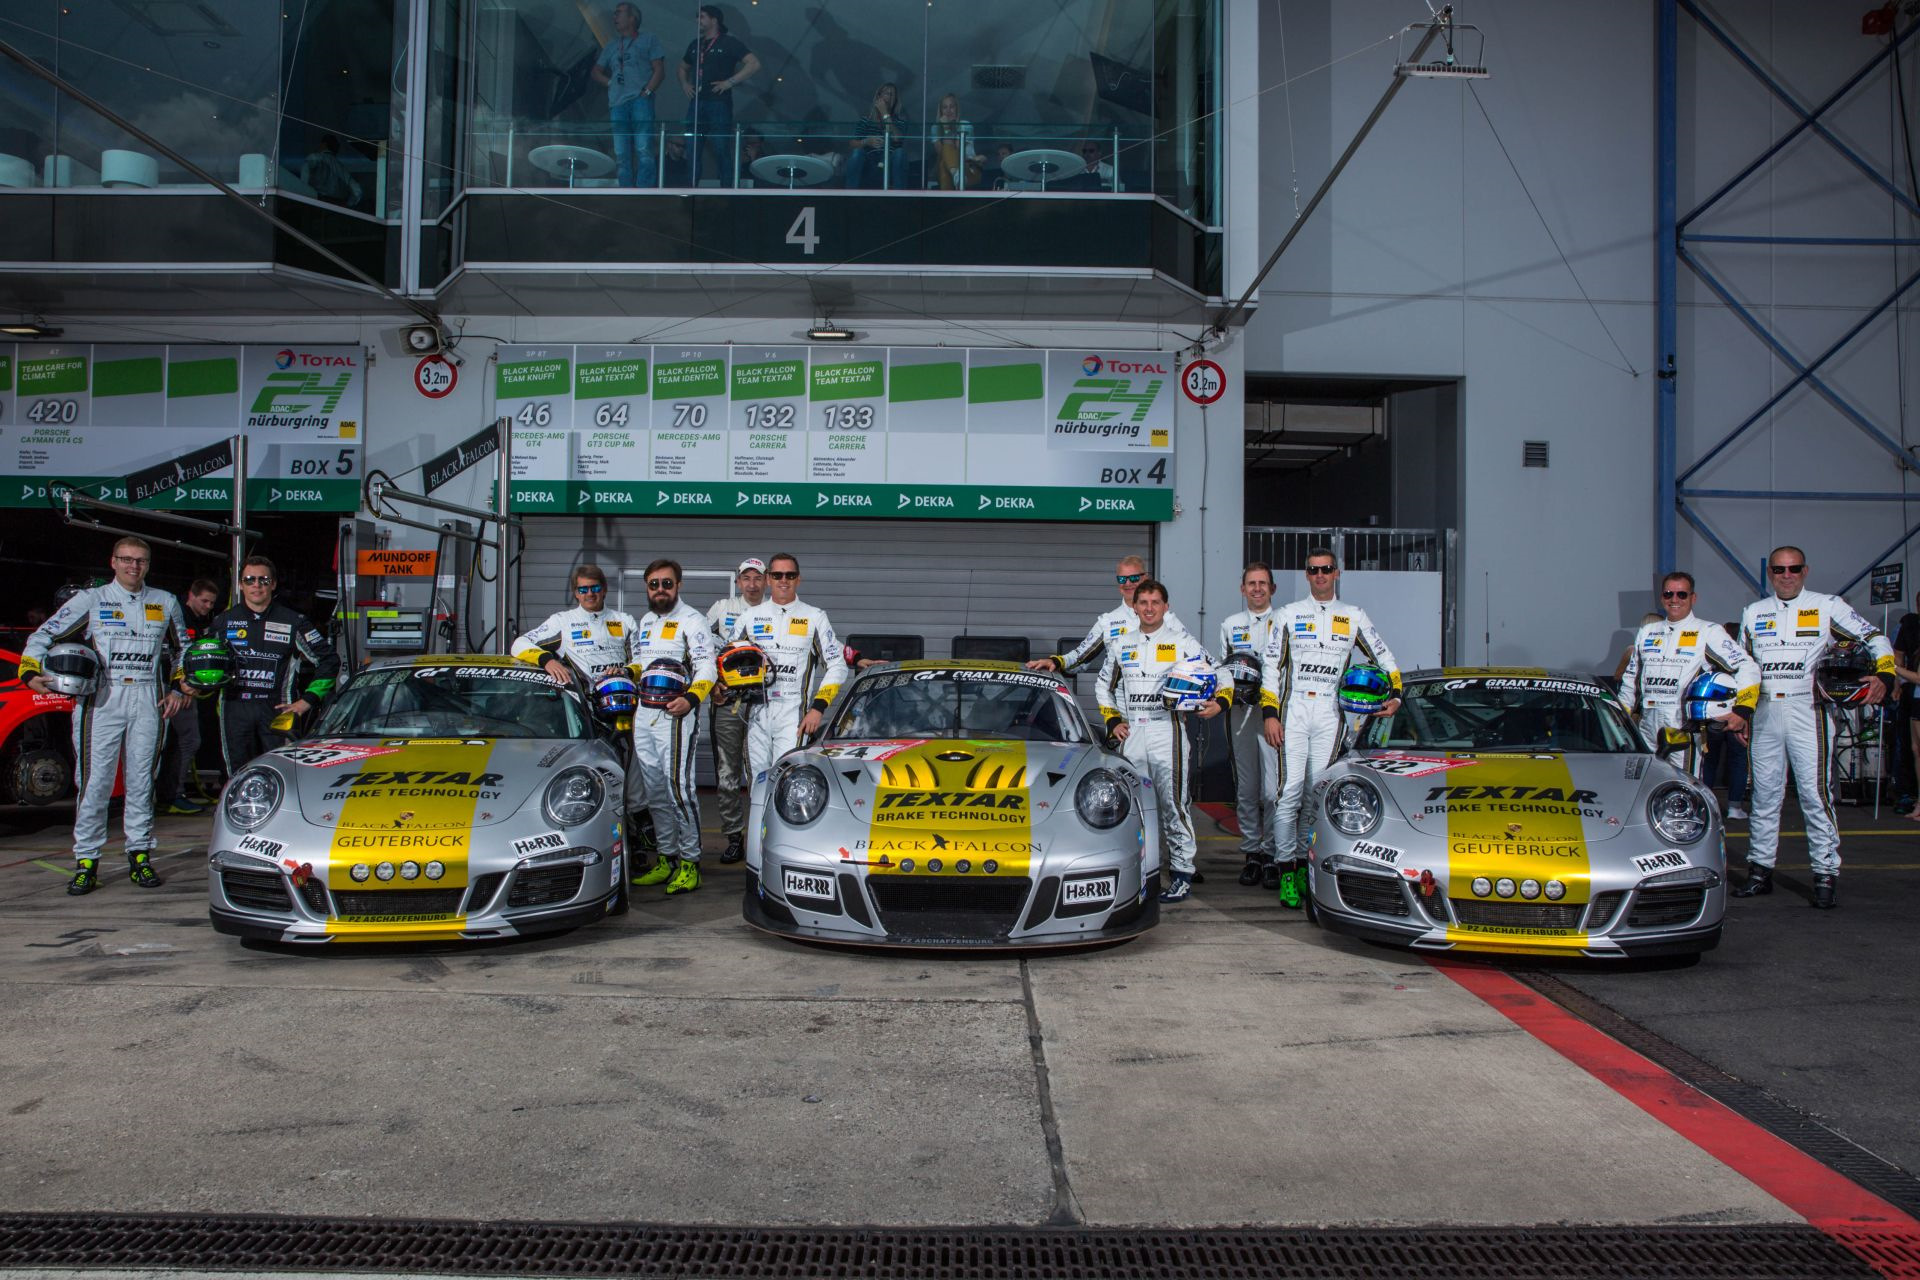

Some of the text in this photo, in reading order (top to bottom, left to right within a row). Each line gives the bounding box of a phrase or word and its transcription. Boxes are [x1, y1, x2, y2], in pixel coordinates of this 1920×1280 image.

[786, 207, 820, 254] 4
[299, 353, 356, 366] TOTAL
[22, 361, 82, 373] TEAM CARE FOR
[502, 364, 561, 376] BLACK FALCON
[580, 364, 639, 376] BLACK FALCON
[657, 365, 717, 376] BLACK FALCON
[736, 366, 796, 377] BLACK FALCON
[815, 366, 875, 378] BLACK FALCON
[1106, 360, 1167, 374] TOTAL
[22, 371, 56, 381] CLIMATE
[503, 373, 555, 384] TEAM KNUFFI
[580, 373, 635, 384] TEAM TEXTAR
[658, 373, 720, 384] TEAM IDENTICA
[737, 374, 793, 385] TEAM TEXTAR
[840, 375, 872, 383] TEXTAR
[28, 401, 77, 423] 420
[518, 403, 552, 426] 46
[596, 403, 629, 426] 64
[673, 404, 707, 427] 70
[746, 404, 795, 428] 132
[824, 405, 874, 429] 133
[248, 415, 329, 429] nürburgring
[34, 428, 71, 436] PORSCHE
[1054, 422, 1140, 437] nürburgring
[21, 436, 54, 444] CAYMAN
[511, 432, 565, 440] ERCEDES-AMG
[526, 440, 541, 448] GT4
[291, 449, 355, 476] BOX 5
[430, 463, 460, 488] BLACK
[465, 437, 496, 467] FALCON
[1101, 457, 1167, 484] BOX 4
[136, 475, 176, 499] BLACK
[185, 454, 227, 481] FALCON
[191, 488, 228, 500] DEKRA
[286, 490, 323, 501] DEKRA
[517, 492, 554, 502] DEKRA
[595, 492, 633, 503] DEKRA
[673, 493, 712, 504] DEKRA
[753, 494, 792, 505] DEKRA
[833, 495, 872, 506] DEKRA
[915, 496, 954, 507] DEKRA
[995, 497, 1035, 508] DEKRA
[1096, 499, 1135, 510] DEKRA
[368, 552, 431, 563] MUNDORF
[384, 564, 413, 574] TANK
[1799, 609, 1819, 617] ADAC
[1333, 615, 1349, 624] ADAC
[111, 652, 153, 662] TEXTAR
[342, 662, 348, 671] 5
[455, 668, 501, 676] GRAN
[1300, 663, 1338, 675] TEXTAR
[1762, 662, 1804, 672] TEXTAR
[524, 678, 565, 689] SIMULATOR
[952, 671, 1060, 688] GRAN TURISMO
[1646, 677, 1678, 686] TEXTAR
[1019, 681, 1058, 691] SIMULATOR
[1485, 679, 1602, 694] GRAN TURISMO
[1129, 693, 1162, 703] TEXTAR
[1557, 688, 1601, 698] SIMULATOR
[820, 747, 869, 758] 64
[329, 771, 504, 788] TEXTAR
[322, 788, 501, 801] BRAKE TECHNOLOGY
[1425, 786, 1599, 804] TEXTAR
[879, 792, 1024, 809] TEXTAR
[1424, 803, 1604, 818] BRAKE TECHNOLOGY
[877, 811, 1026, 824] BRAKE TECHNOLOGY
[342, 821, 466, 829] BLACK FALCON
[337, 835, 464, 848] GEUTEBRÜCK
[1453, 832, 1578, 842] BLACK FALCON
[855, 840, 1042, 852] BLACK FALCON
[1453, 842, 1581, 858] GEUTEBRÜCK
[363, 913, 447, 922] ASCHAFFENBURG
[1482, 925, 1567, 936] ASCHAFFENBURG
